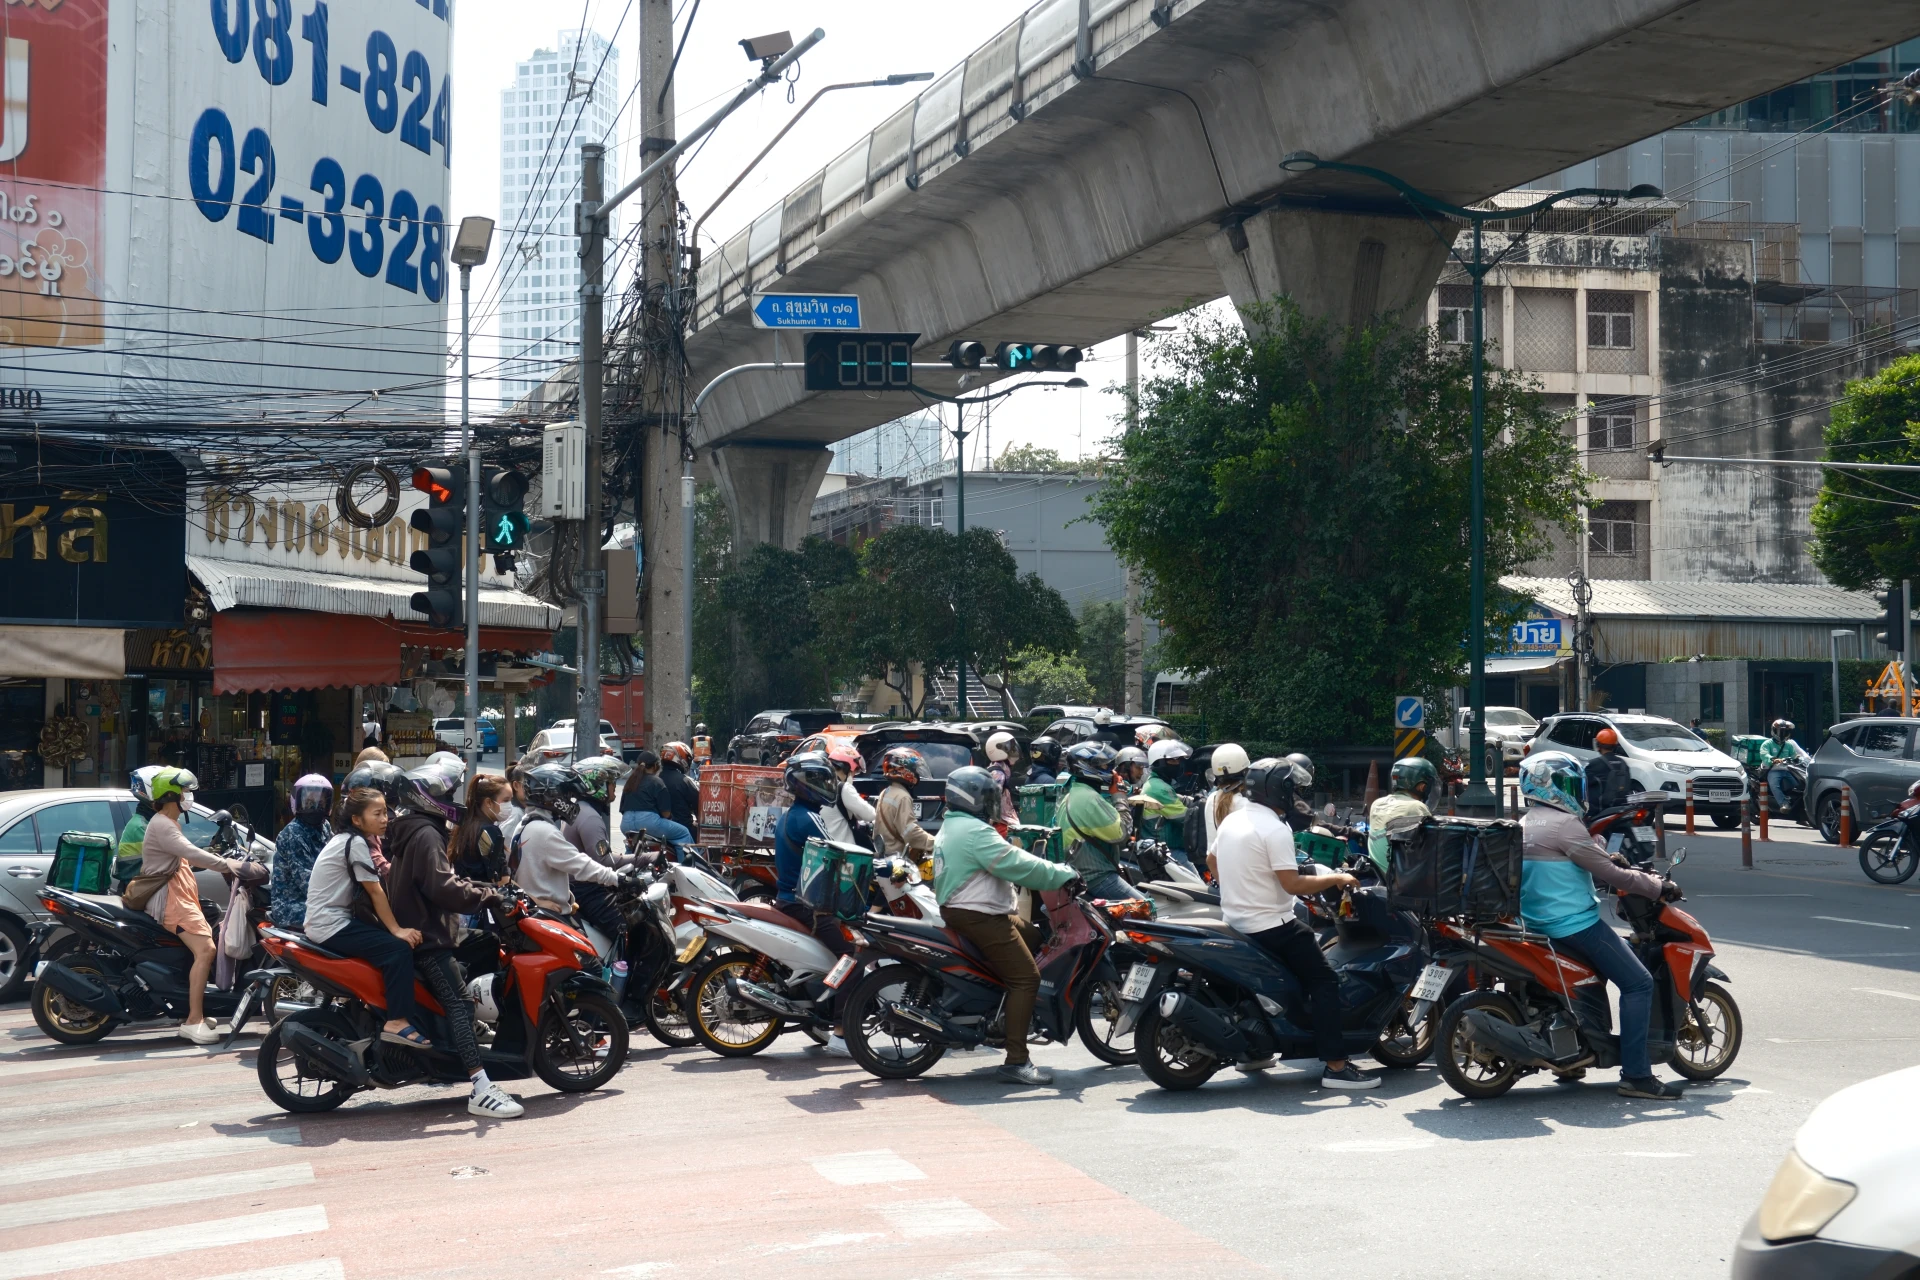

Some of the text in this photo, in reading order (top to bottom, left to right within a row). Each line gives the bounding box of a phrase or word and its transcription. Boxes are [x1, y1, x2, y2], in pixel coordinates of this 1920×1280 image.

[785, 298, 828, 317] สุขุมวิท
[777, 317, 817, 325] Sukhumvit
[823, 318, 831, 326] 71
[1512, 620, 1556, 644] ป้าย
